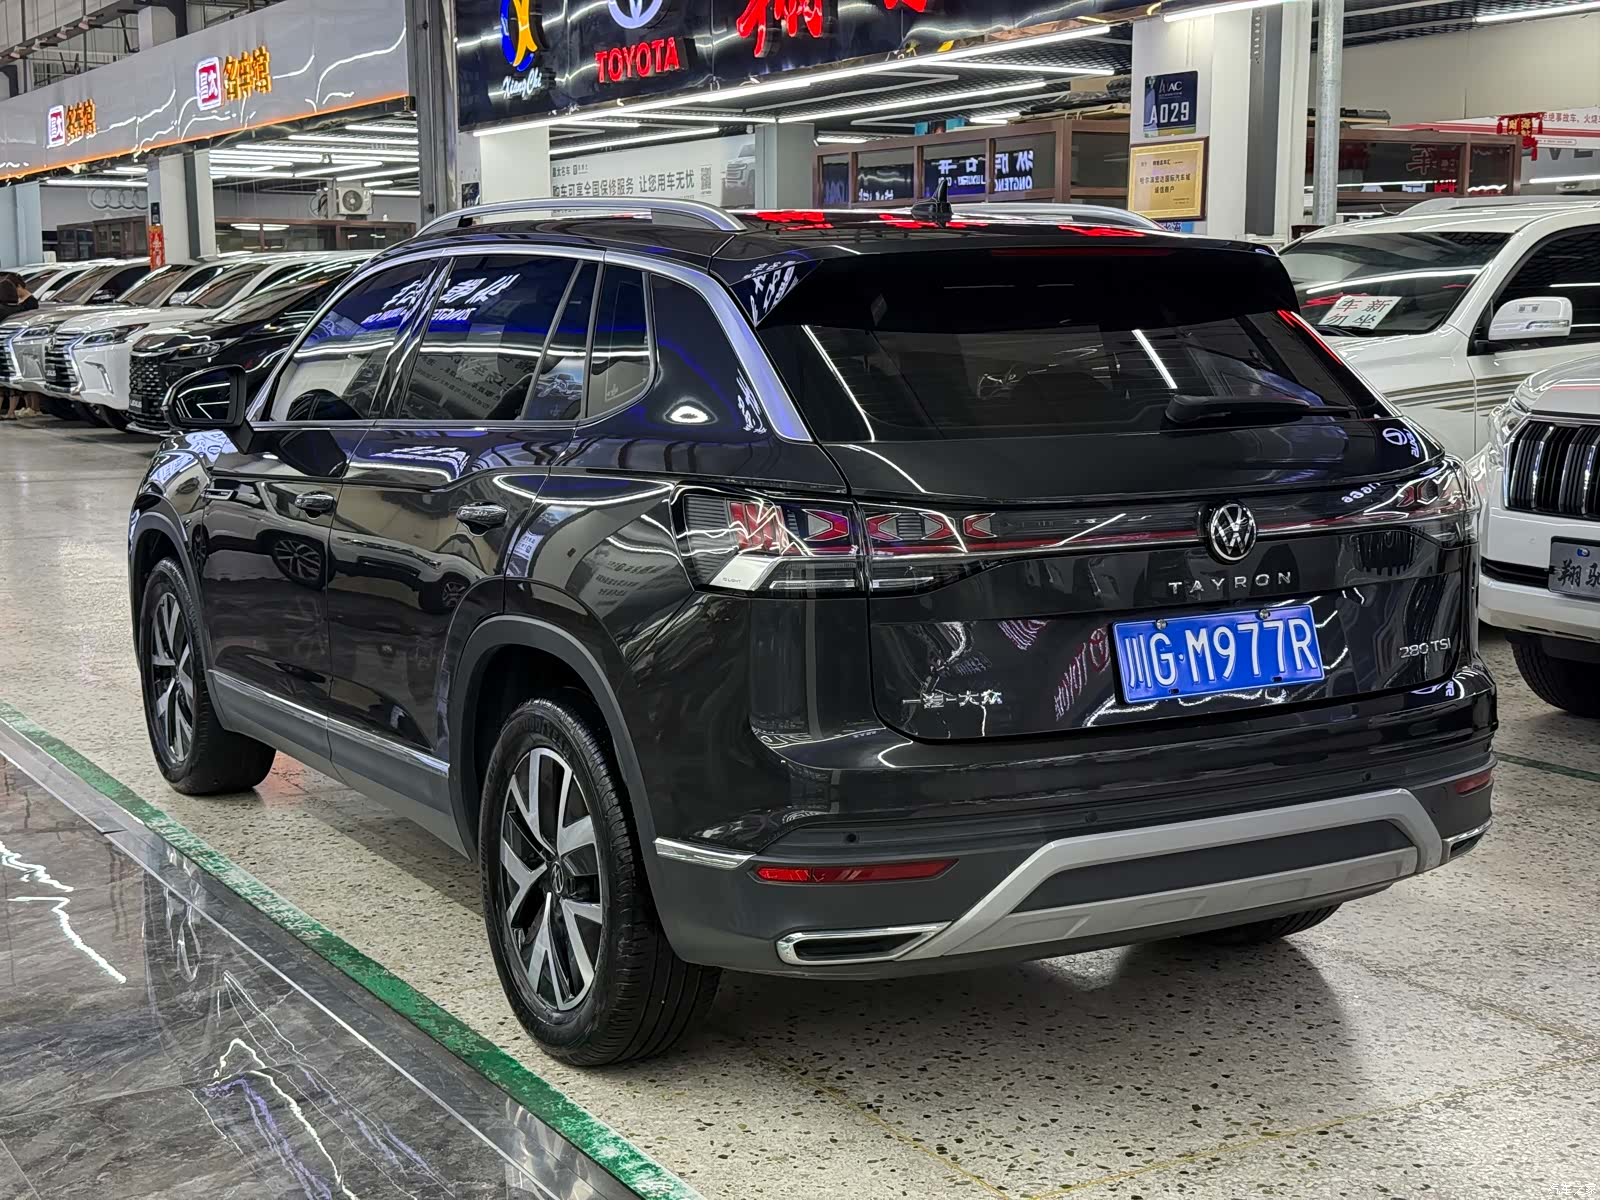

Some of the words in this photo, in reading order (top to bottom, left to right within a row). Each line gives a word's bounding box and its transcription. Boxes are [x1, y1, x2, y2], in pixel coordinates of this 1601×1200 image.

[595, 37, 679, 83] TOYOTA
[1150, 101, 1190, 124] A029
[638, 169, 695, 193] 让您用车无忧
[1168, 571, 1292, 595] TAYRON
[1399, 642, 1429, 659] 280
[1430, 637, 1451, 652] TSI
[902, 689, 1003, 709] 一汽-大众
